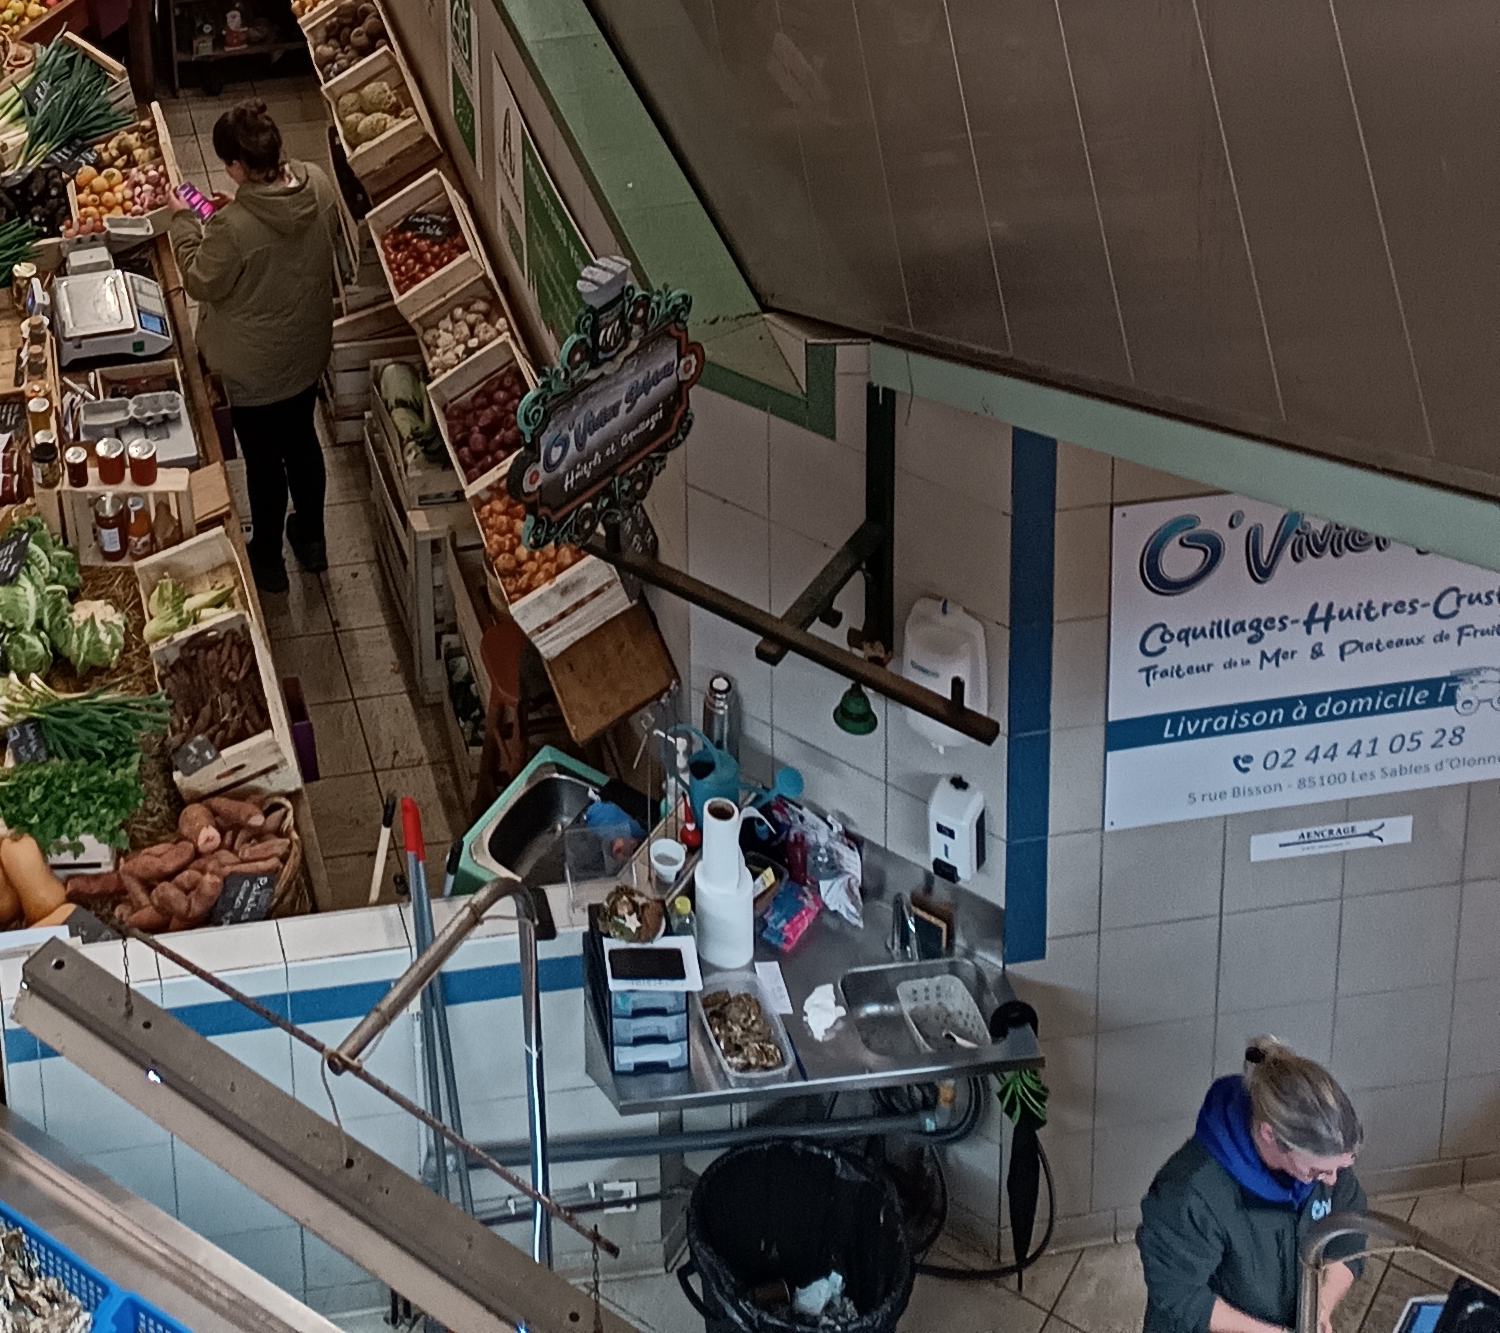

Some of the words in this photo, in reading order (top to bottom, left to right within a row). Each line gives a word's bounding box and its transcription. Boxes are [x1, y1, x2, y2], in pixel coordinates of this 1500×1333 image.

[1138, 661, 1214, 687] Traiteur
[1259, 647, 1298, 671] Mer
[1310, 642, 1325, 661] &
[1338, 632, 1426, 662] Plateaux
[1432, 628, 1450, 644] de
[1163, 703, 1284, 739] Livraison
[1292, 699, 1308, 722] à
[1314, 684, 1429, 717] domicile
[1437, 681, 1448, 703] !
[1262, 748, 1296, 772] 02
[1304, 742, 1340, 765] 44
[1346, 736, 1379, 759] 41
[1388, 730, 1423, 755] 05
[1430, 726, 1466, 751] 28
[1187, 792, 1197, 805] 5
[1201, 789, 1228, 803] rue
[1232, 781, 1284, 800] Bisson
[1296, 771, 1349, 791] 85100
[1351, 767, 1377, 784] Les
[1380, 760, 1431, 780] Sables
[1297, 824, 1358, 842] AENCRAGE
